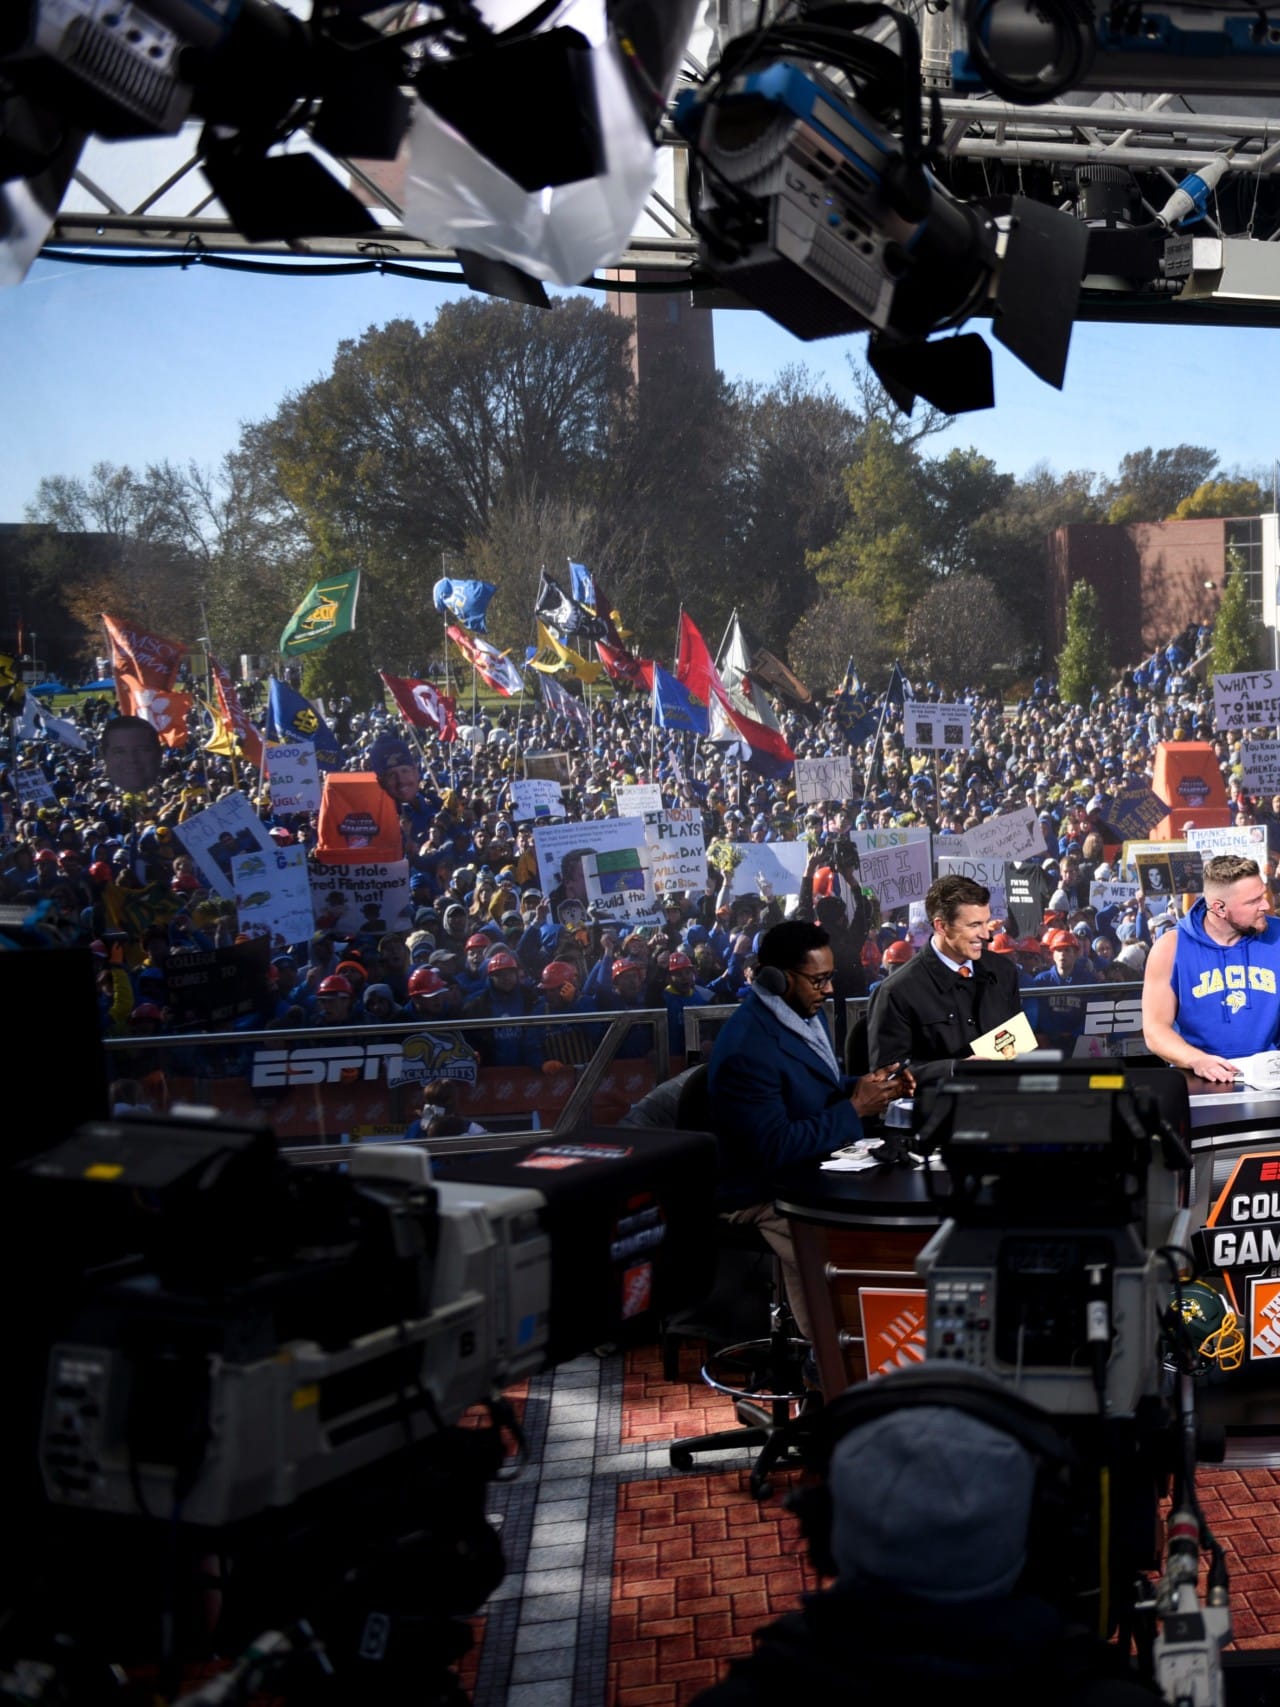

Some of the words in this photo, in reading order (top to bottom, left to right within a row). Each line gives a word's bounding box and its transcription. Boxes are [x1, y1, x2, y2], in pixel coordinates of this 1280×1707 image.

[1217, 673, 1273, 693] WHAT'S
[1240, 691, 1251, 701] A
[1226, 714, 1246, 726] ASK
[1246, 713, 1262, 724] ME
[266, 748, 300, 760] GOOD
[1251, 753, 1277, 764] FROM
[798, 760, 832, 783] BUCK
[271, 775, 294, 786] BAD
[273, 796, 303, 808] UGLY
[644, 811, 664, 825] IF
[657, 822, 701, 840] PLAYS
[1190, 829, 1228, 840] THANKS
[866, 832, 908, 849] NDSU
[1195, 836, 1248, 849] BRINGING
[308, 865, 350, 877] NDSU
[354, 864, 388, 877] stole
[858, 855, 889, 882] PAT
[947, 861, 1004, 882] NDSU
[338, 876, 407, 891] Flintstone's
[354, 889, 385, 903] hat!
[594, 893, 625, 909] Build
[628, 890, 646, 903] the
[1192, 965, 1277, 999] JACKS
[1084, 999, 1144, 1035] ES
[252, 1043, 404, 1088] ESPN
[877, 1306, 924, 1349] THE
